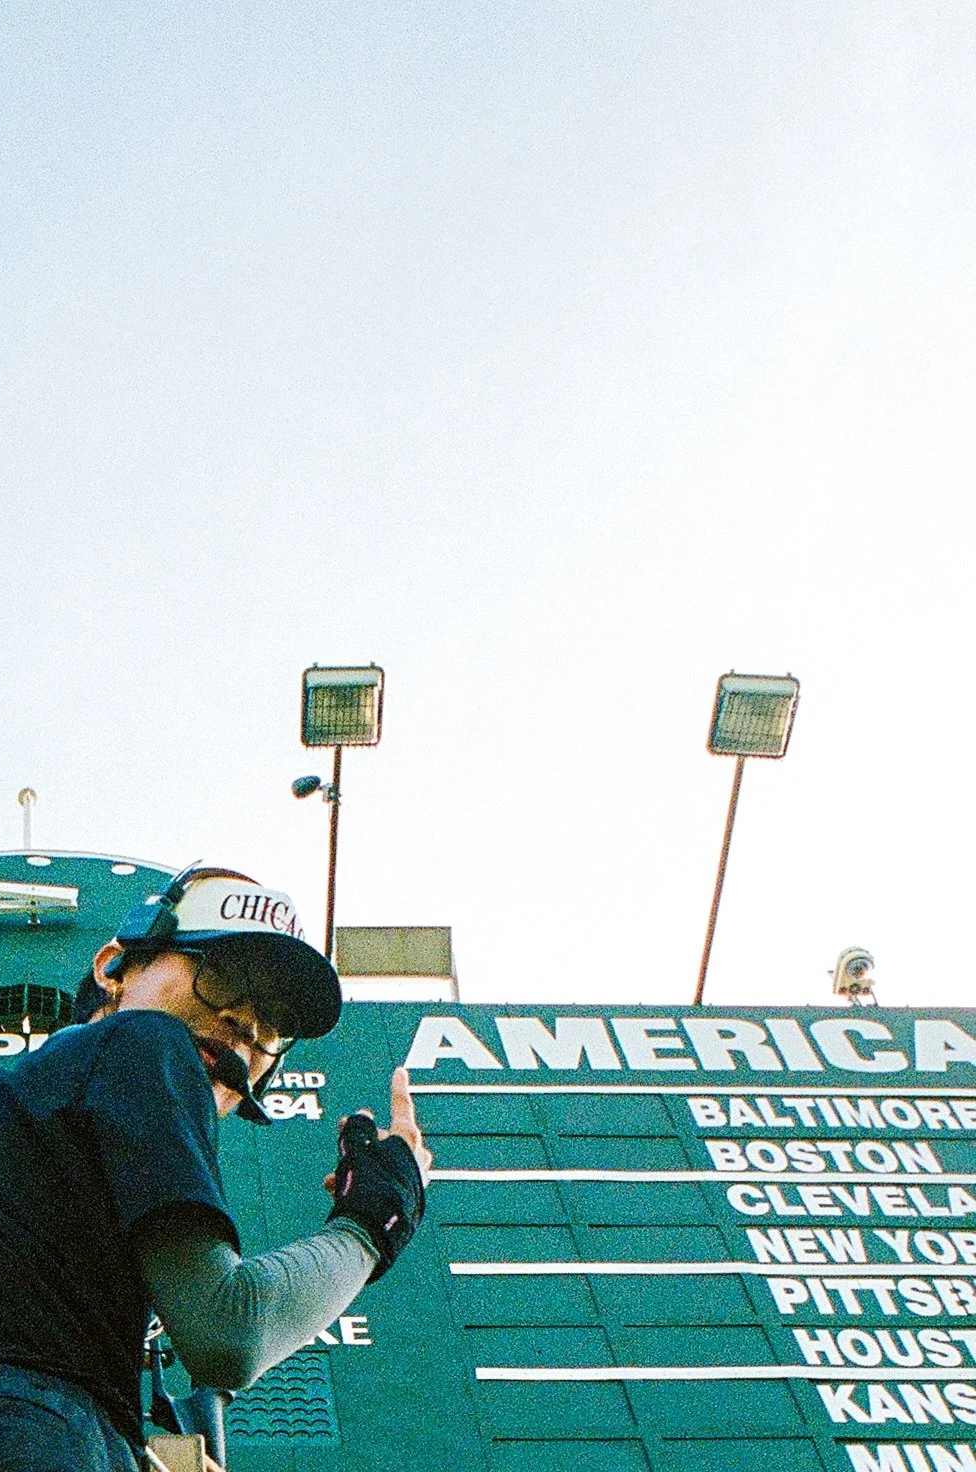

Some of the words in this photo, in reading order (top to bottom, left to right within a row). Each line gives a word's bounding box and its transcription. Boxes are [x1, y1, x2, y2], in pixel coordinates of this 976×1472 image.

[404, 1017, 976, 1072] AMERICA
[262, 1094, 324, 1121] 84
[705, 1140, 944, 1174] BOSTON
[745, 1229, 868, 1263] NEW
[766, 1277, 976, 1317] PITTSB
[816, 1383, 976, 1425] KANS
